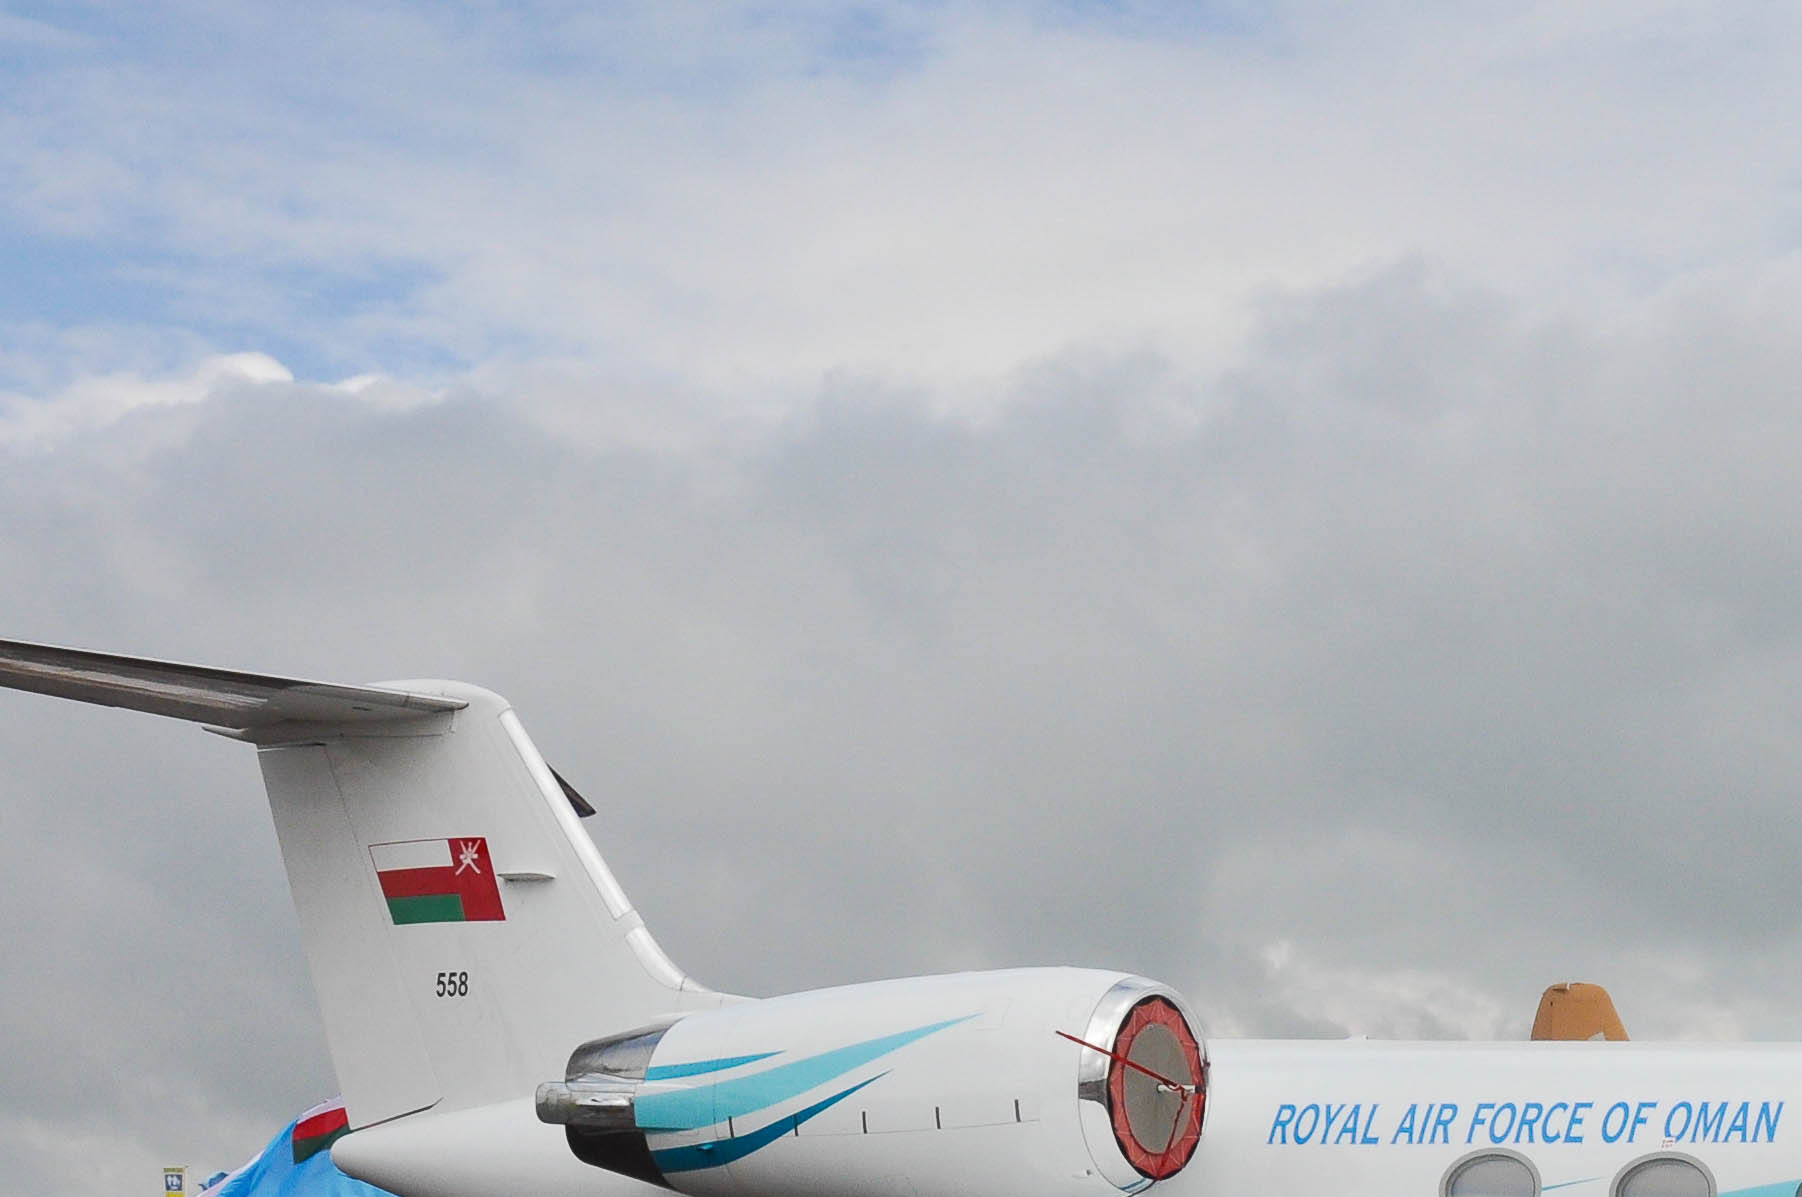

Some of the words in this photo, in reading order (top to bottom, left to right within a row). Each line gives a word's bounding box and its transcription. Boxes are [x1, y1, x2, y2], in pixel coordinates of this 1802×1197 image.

[436, 971, 469, 997] 558
[1267, 1103, 1380, 1145] ROYAL
[1390, 1103, 1459, 1145] AIR
[1466, 1101, 1593, 1145] FORCE
[1601, 1101, 1657, 1145] OF
[1663, 1100, 1785, 1145] OMAN
